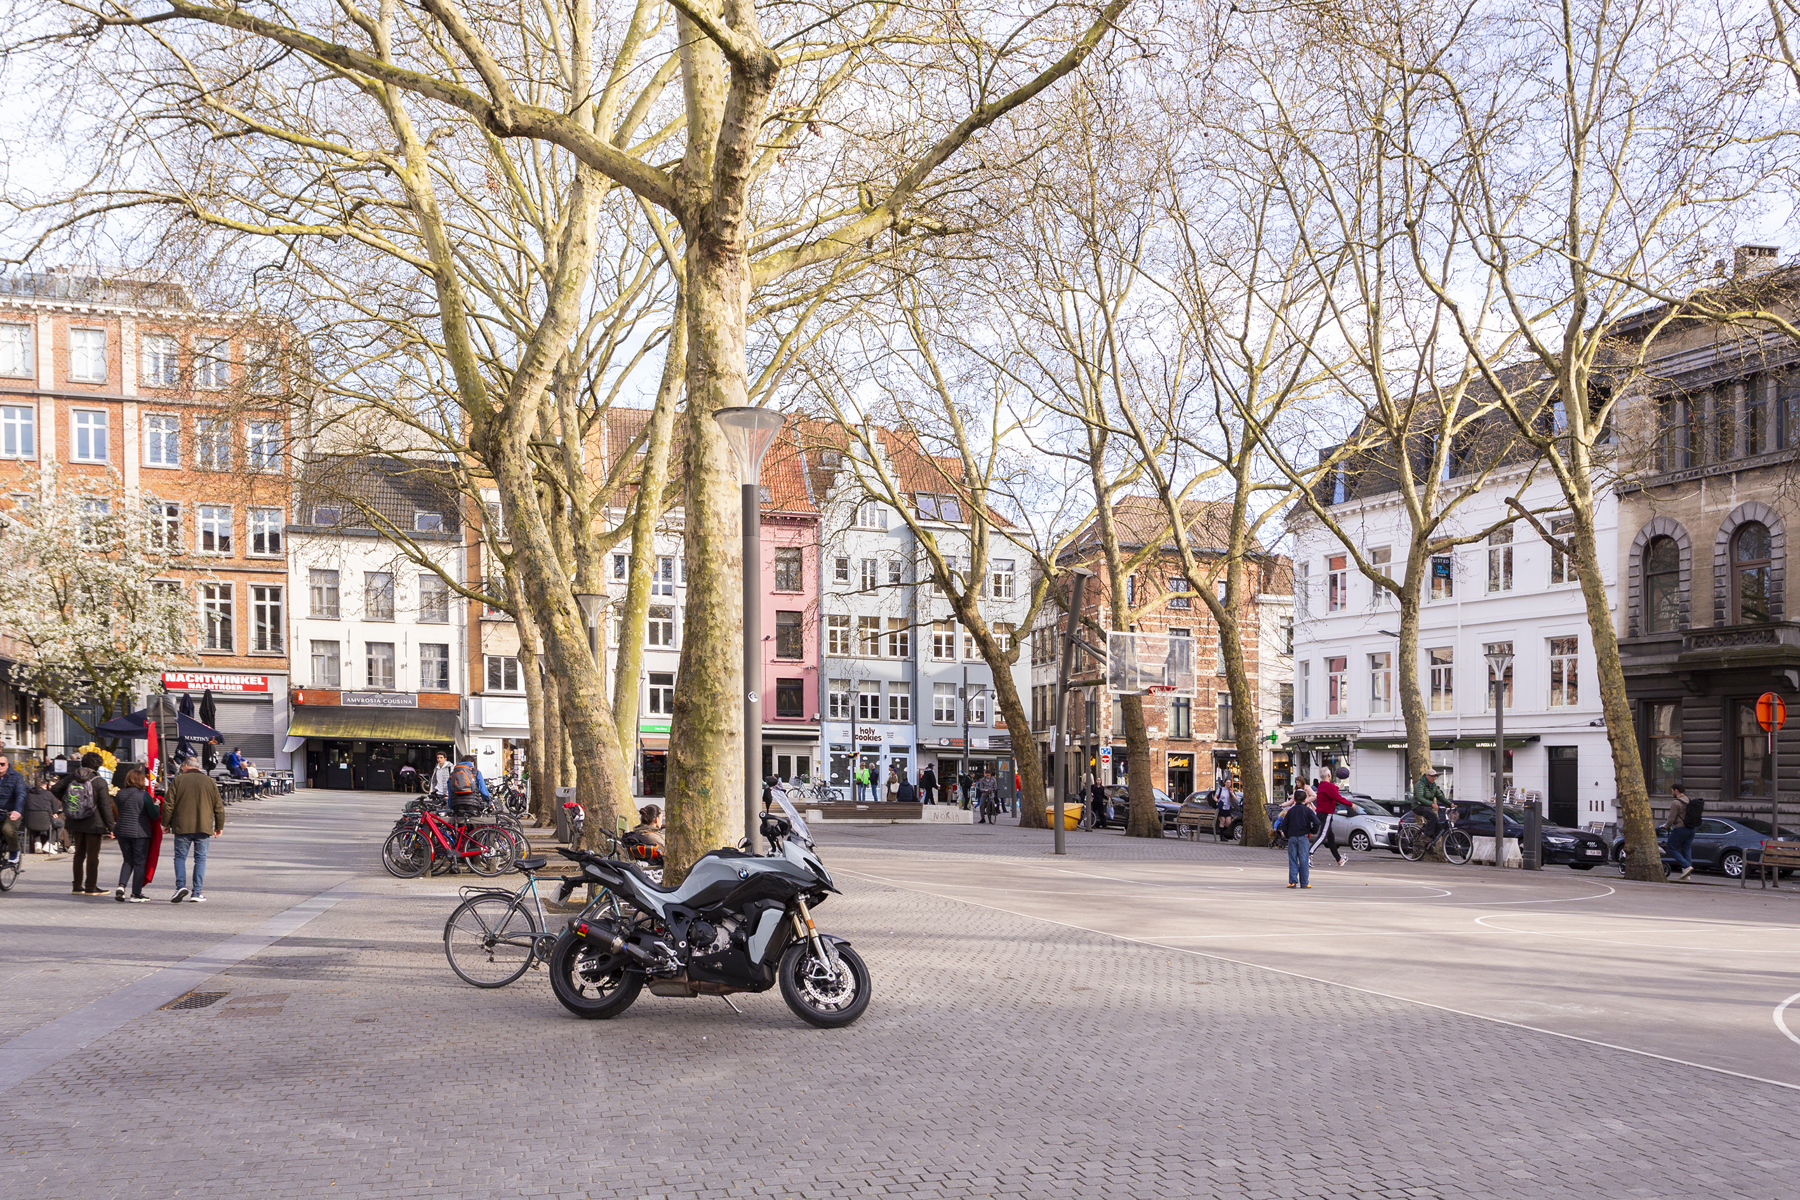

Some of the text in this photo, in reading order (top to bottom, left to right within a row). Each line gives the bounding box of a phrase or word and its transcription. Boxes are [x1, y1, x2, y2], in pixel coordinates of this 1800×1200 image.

[165, 673, 265, 685] NACHTWINKEL
[187, 682, 243, 690] NACHTROER
[859, 727, 876, 735] holy
[855, 734, 882, 742] cookies
